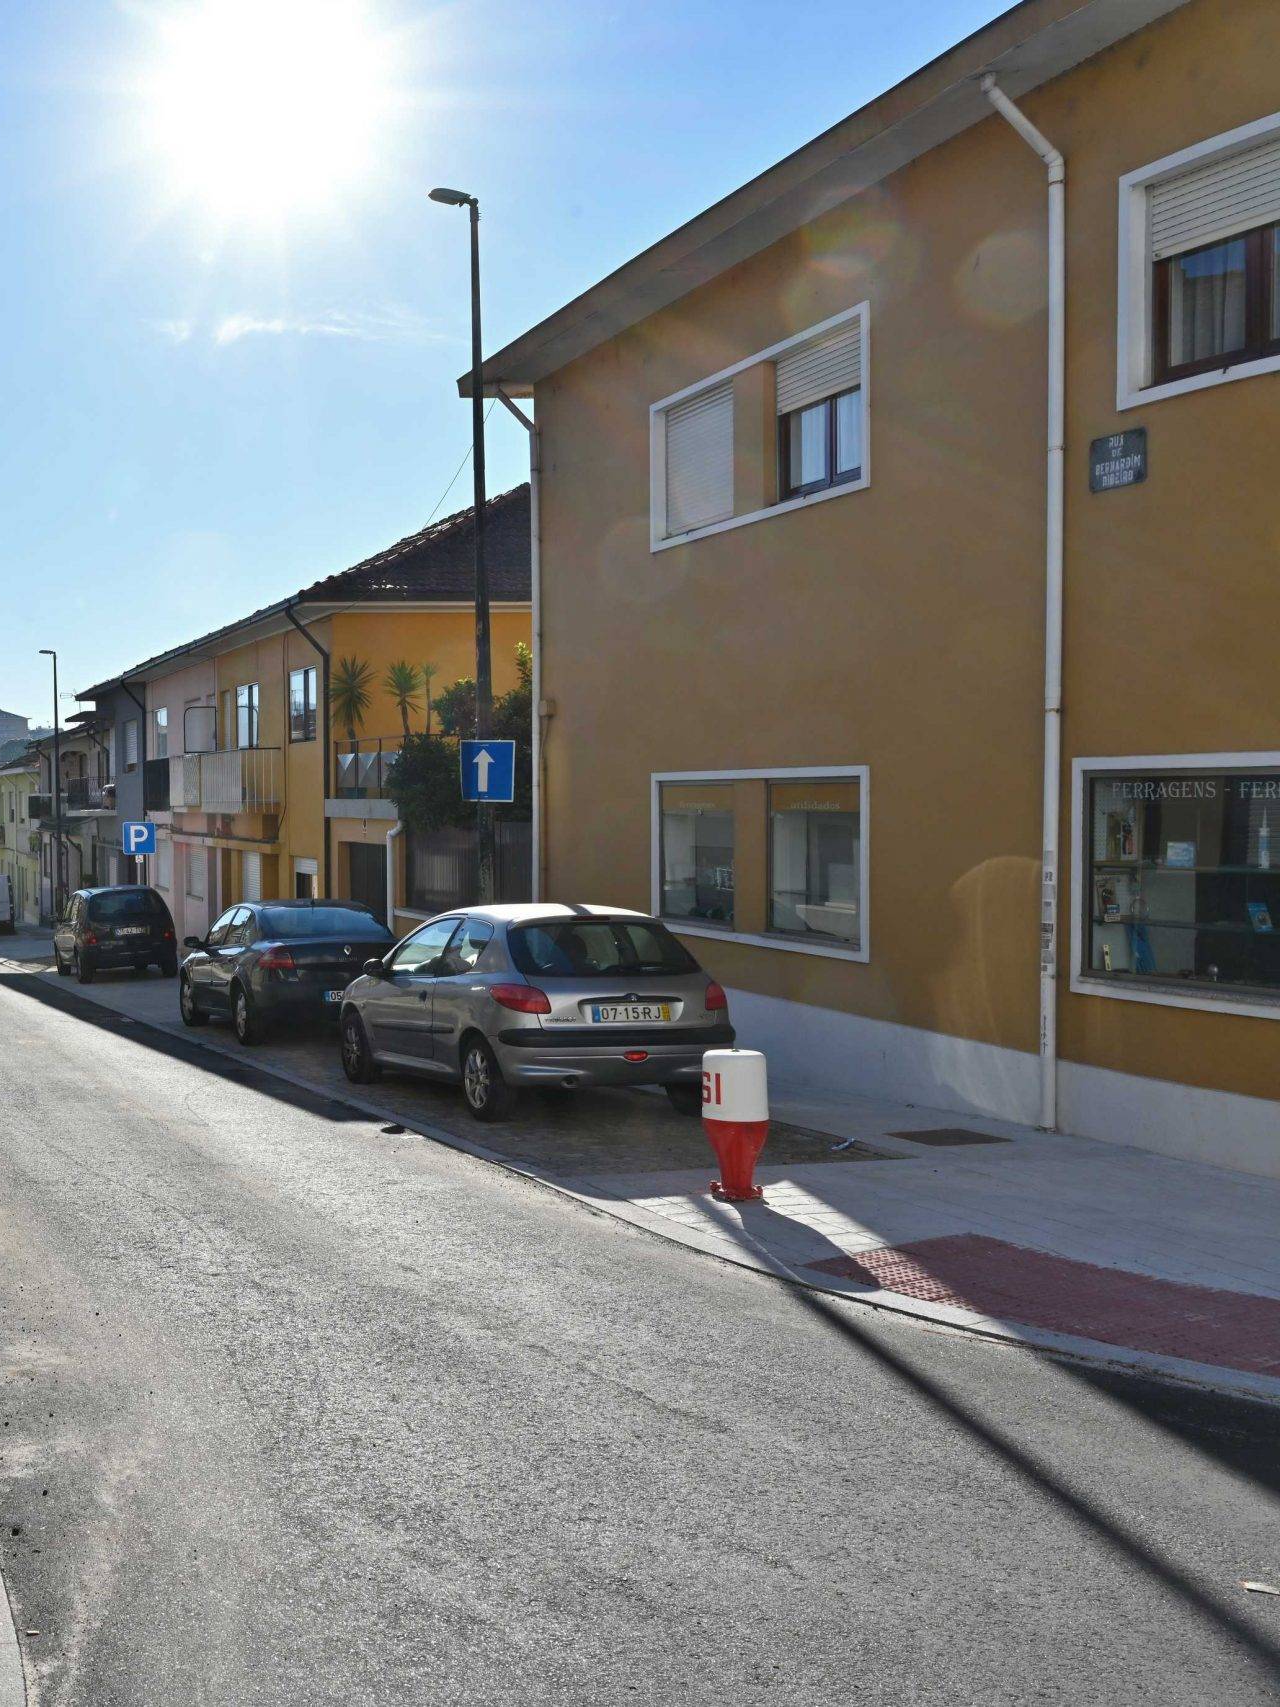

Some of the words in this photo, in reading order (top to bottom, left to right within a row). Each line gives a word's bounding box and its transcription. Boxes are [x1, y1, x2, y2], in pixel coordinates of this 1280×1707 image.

[1108, 434, 1124, 448] RUA
[1112, 781, 1216, 800] FERRAGENS
[1240, 780, 1280, 799] FER
[129, 825, 149, 852] P
[600, 1005, 662, 1020] 07-15-RJ
